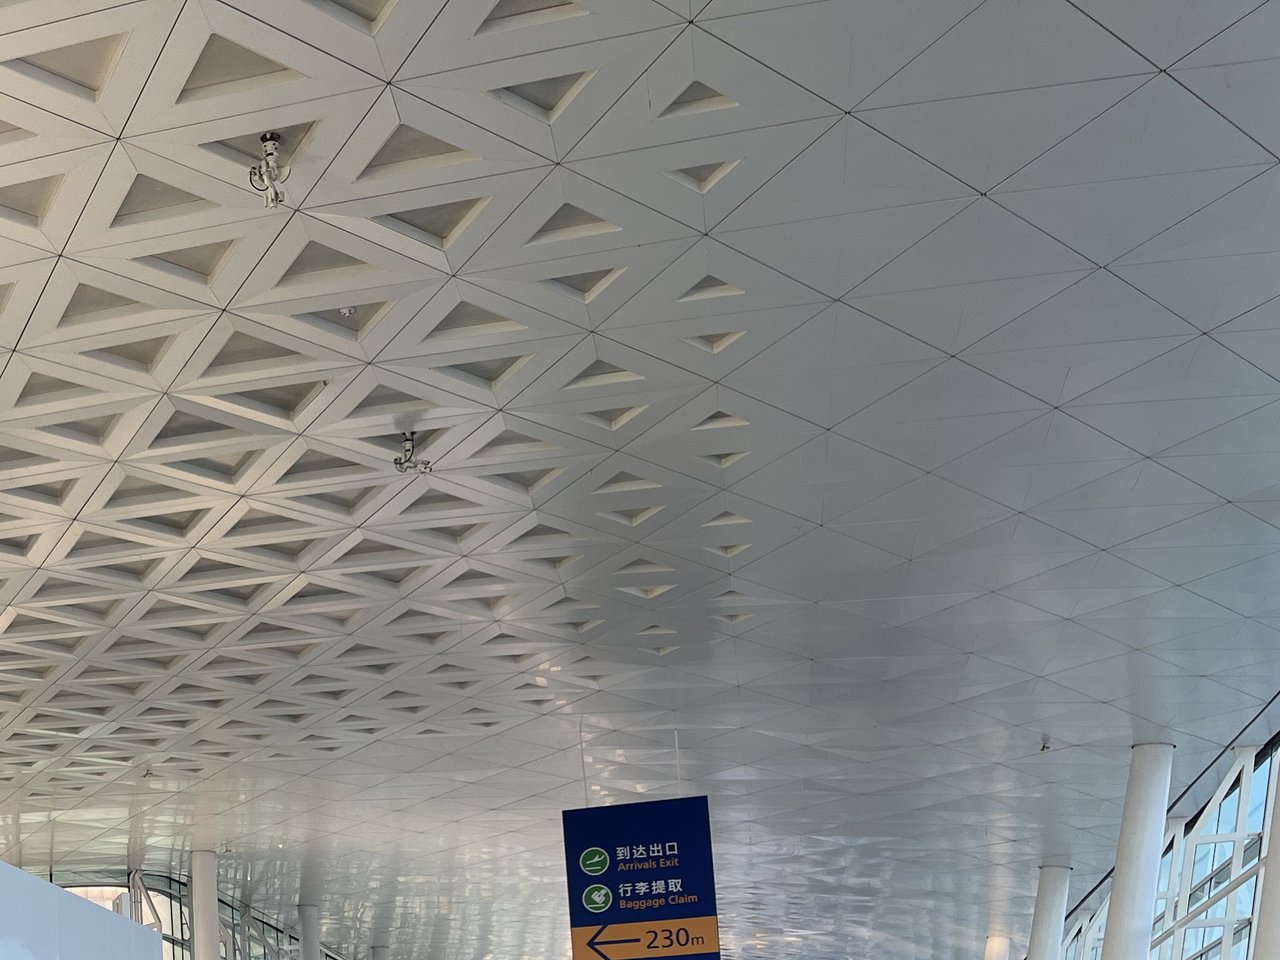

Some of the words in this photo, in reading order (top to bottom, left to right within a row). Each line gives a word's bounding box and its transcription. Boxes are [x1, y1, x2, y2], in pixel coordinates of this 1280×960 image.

[616, 842, 678, 860] 到达出口
[618, 860, 657, 871] Arrivals
[660, 858, 680, 868] Exit
[619, 879, 683, 897] 行李提取
[620, 898, 665, 909] Baggage
[668, 894, 698, 904] Claim
[646, 928, 705, 949] 230m
